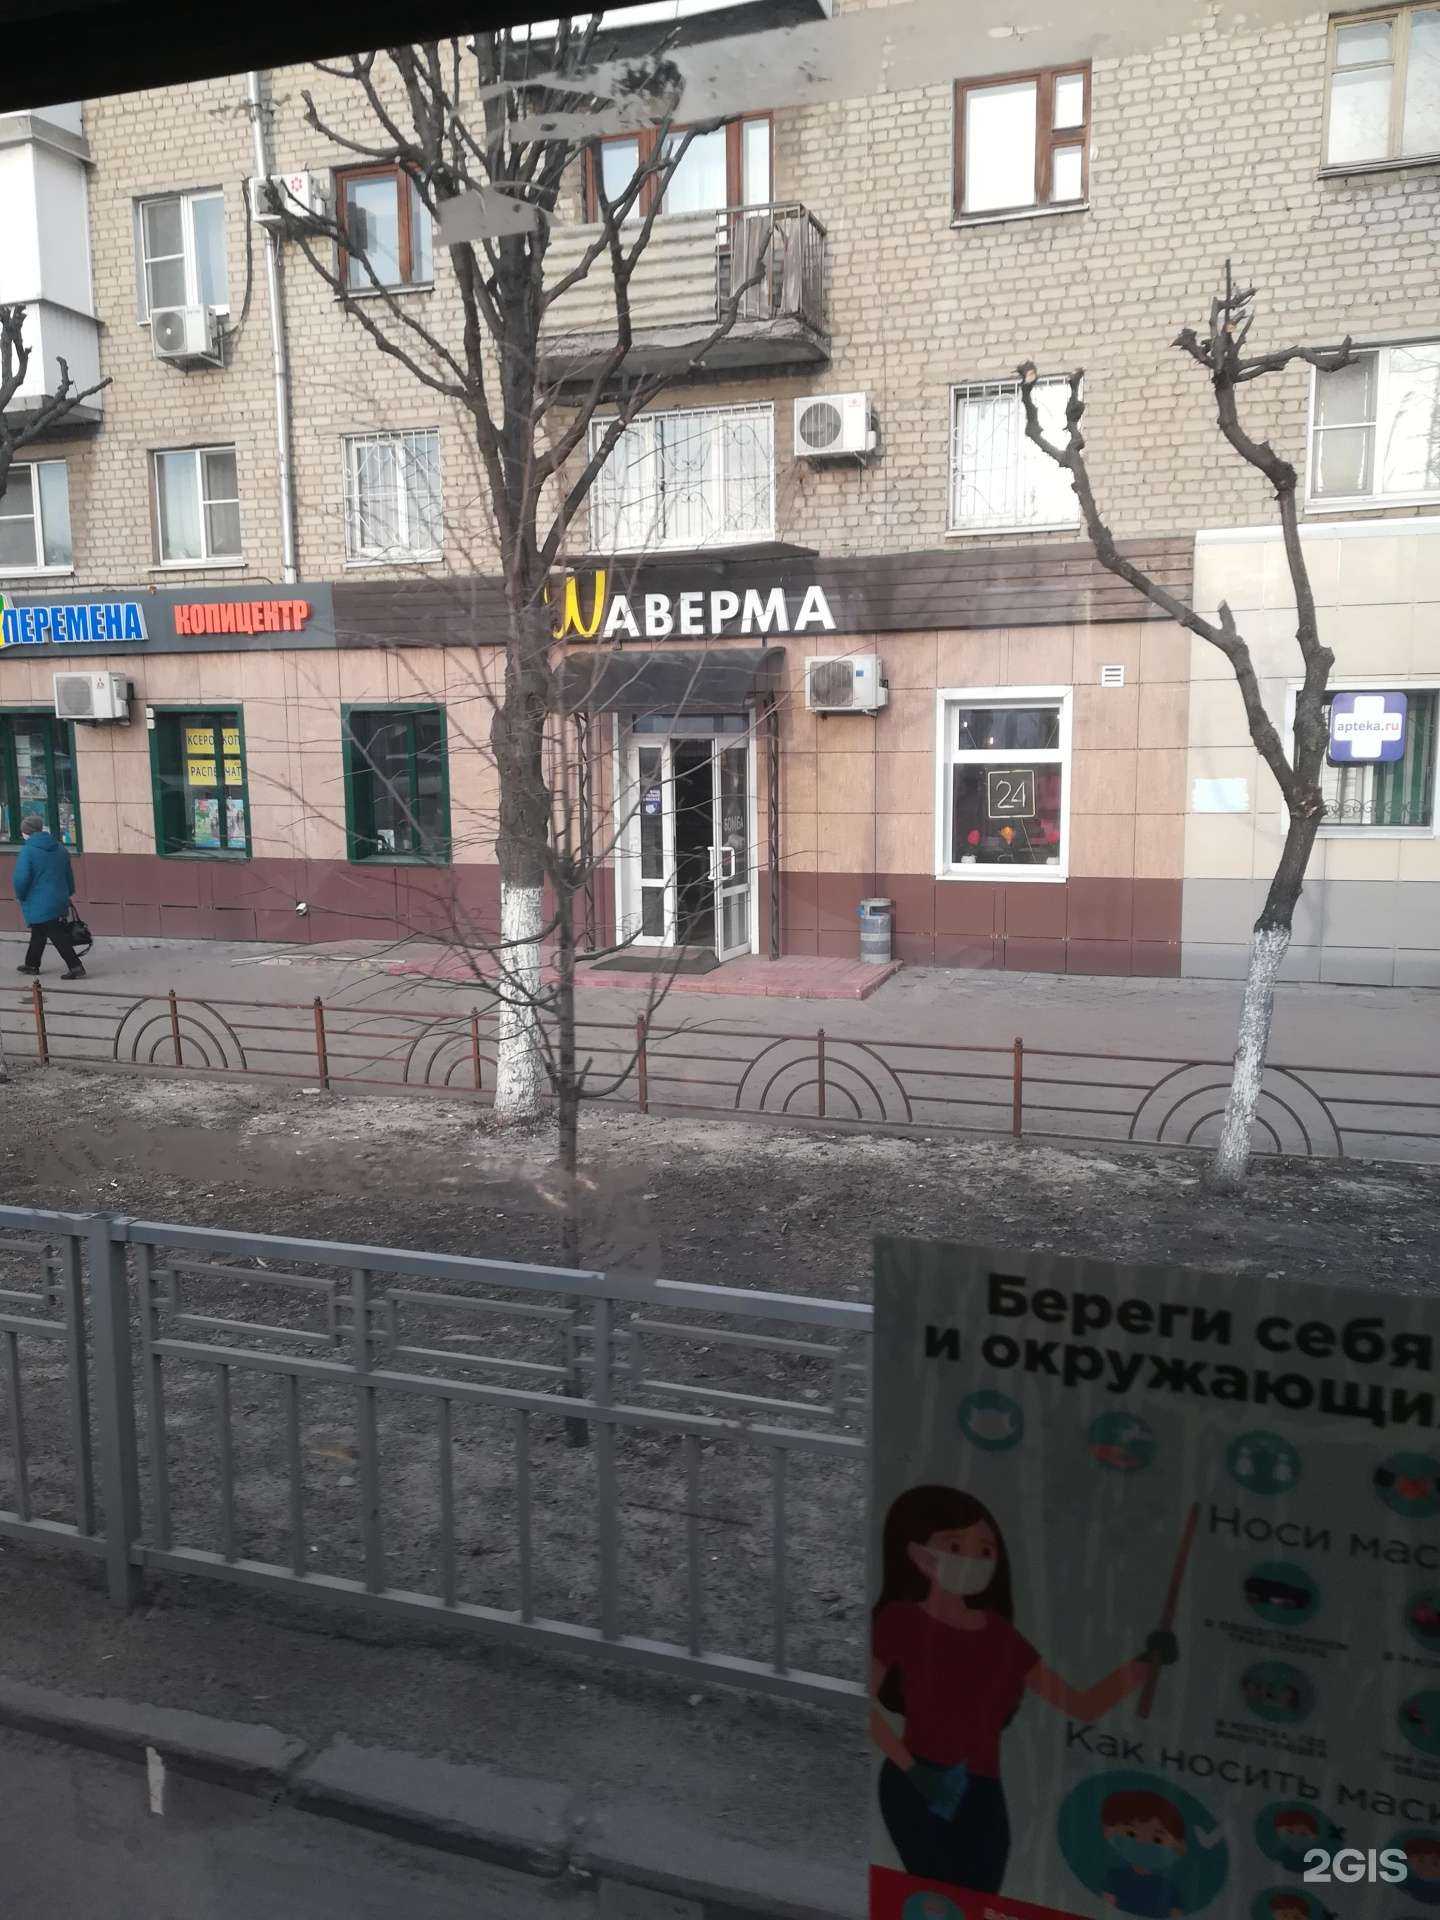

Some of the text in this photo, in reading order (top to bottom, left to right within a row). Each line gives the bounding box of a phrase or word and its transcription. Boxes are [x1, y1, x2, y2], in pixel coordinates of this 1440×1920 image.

[3, 603, 146, 644] ПЕРЕМЕНА
[173, 600, 309, 635] КОПИЦЕНТР
[1337, 720, 1400, 734] apteka.ru
[996, 779, 1027, 809] 24
[986, 1272, 1433, 1372] Береги себя
[924, 1324, 1440, 1430] и окружающи
[1208, 1504, 1332, 1552] Носи
[1065, 1720, 1146, 1764] Как
[1160, 1746, 1322, 1801] носить
